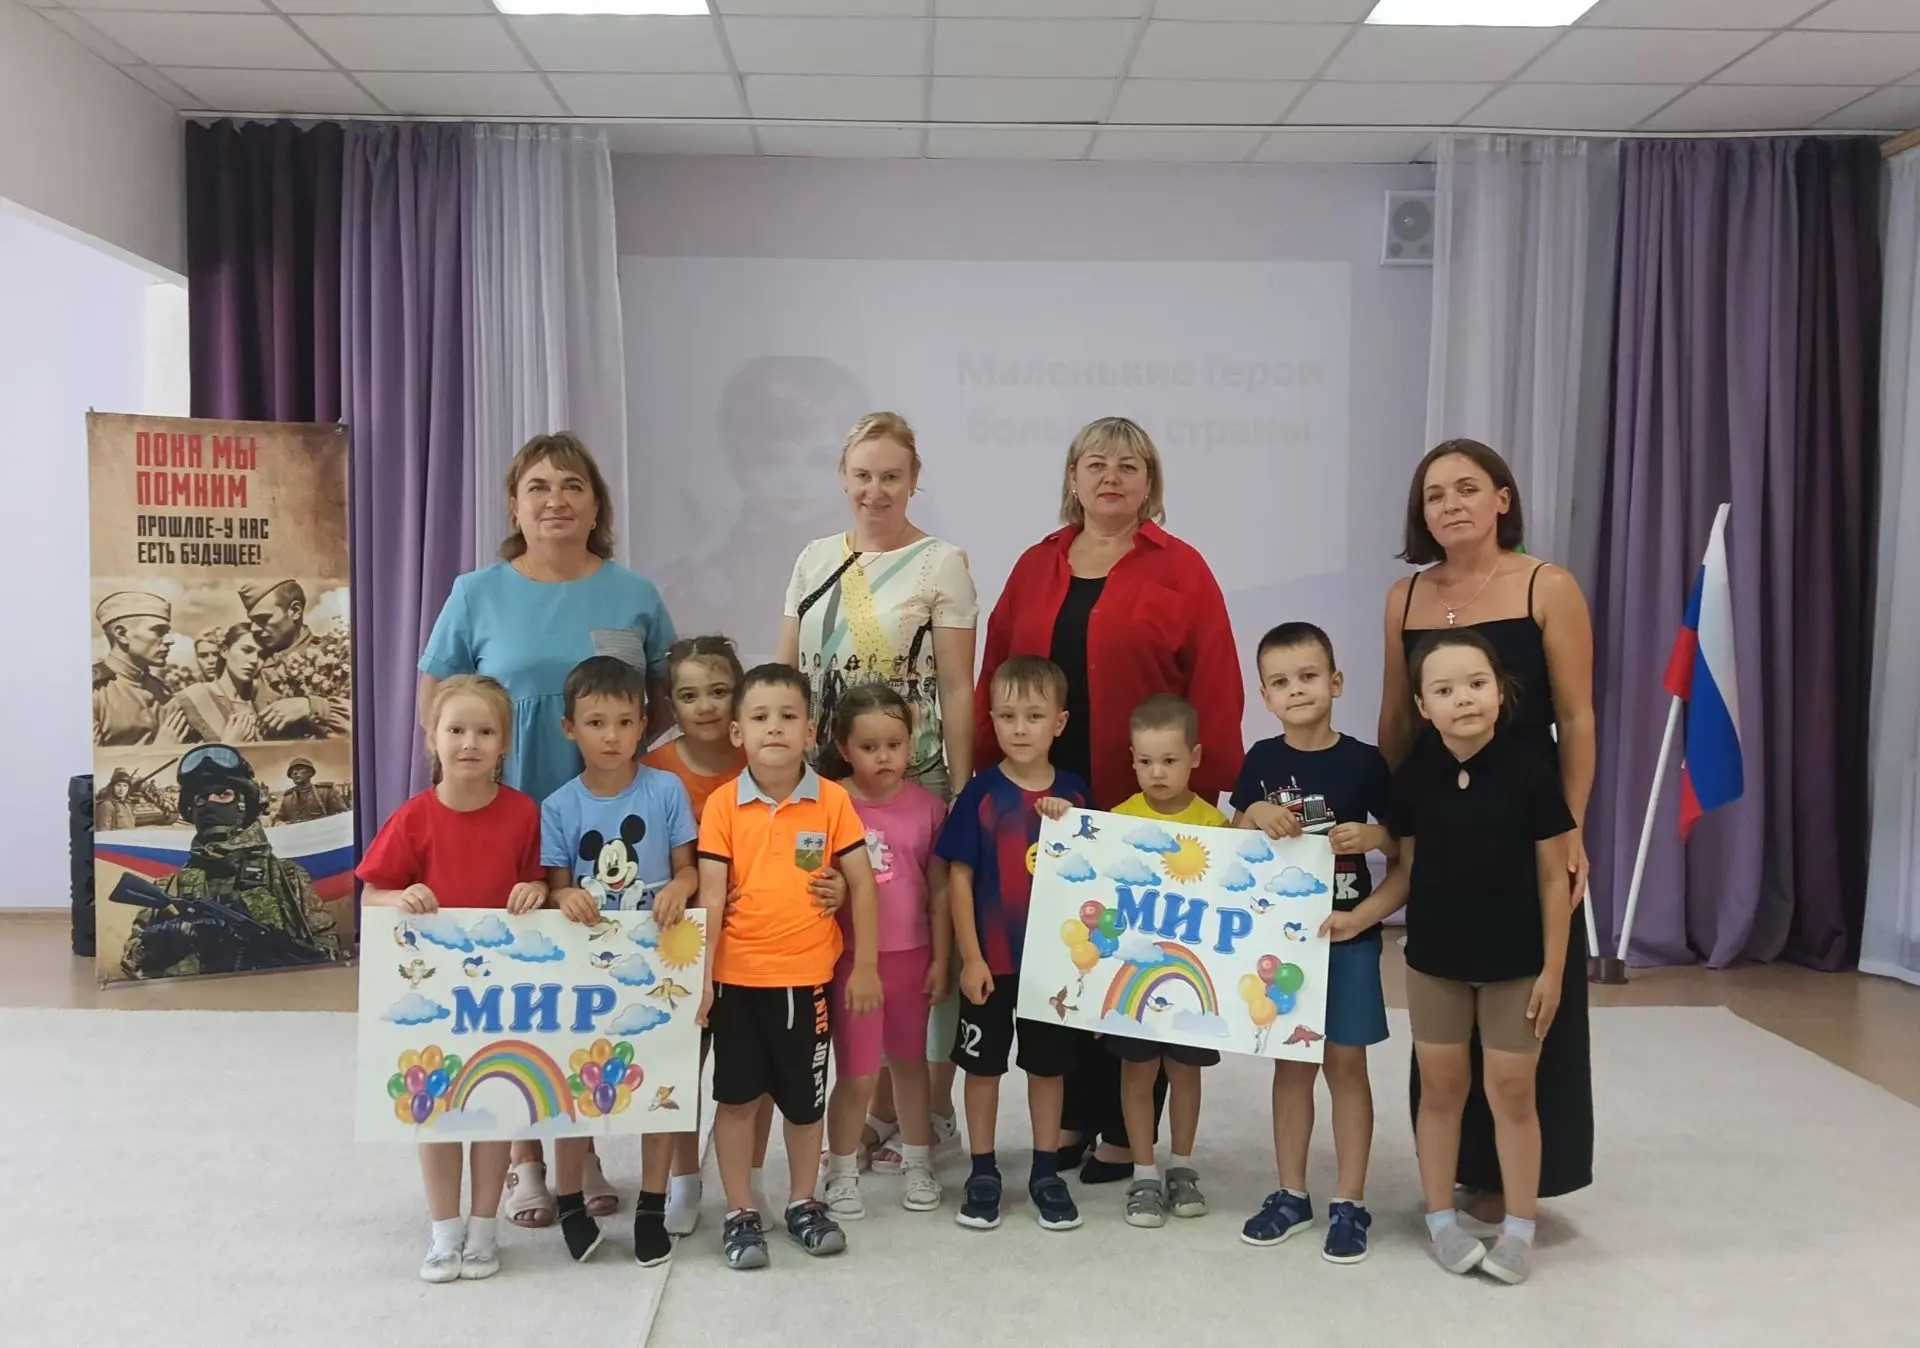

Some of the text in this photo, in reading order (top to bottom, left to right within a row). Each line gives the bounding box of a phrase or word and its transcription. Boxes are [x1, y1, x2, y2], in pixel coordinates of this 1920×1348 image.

[956, 352, 1194, 387] Маленькие
[136, 431, 257, 471] ПОКА МЫ
[1165, 416, 1312, 453] страны
[136, 470, 248, 508] ПОМНИМ
[239, 517, 270, 540] НАС
[137, 541, 262, 567] ЕСТЬ БУДУЩЕЕ!
[1114, 885, 1254, 954] МИР
[451, 982, 618, 1035] МИР
